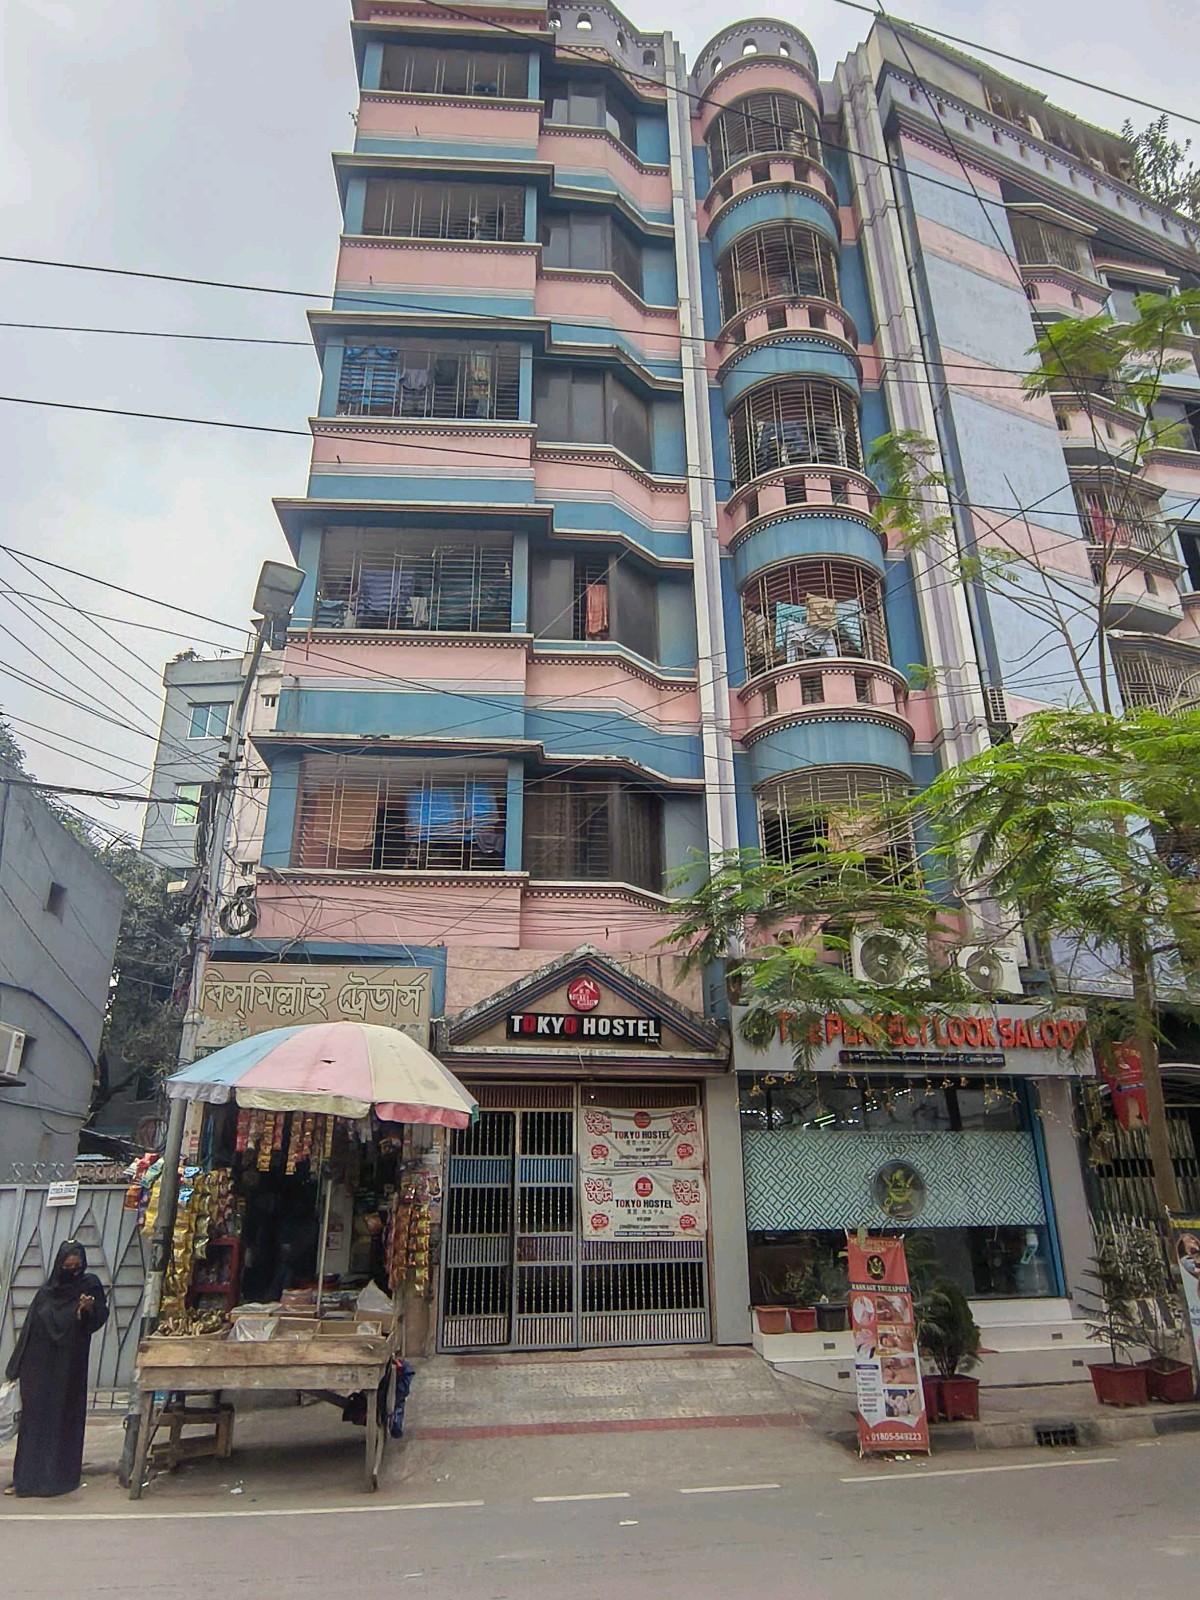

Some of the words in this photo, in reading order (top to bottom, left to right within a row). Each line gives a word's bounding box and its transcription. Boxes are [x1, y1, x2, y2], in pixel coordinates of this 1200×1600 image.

[338, 971, 428, 1019] ট্রেডার্স
[511, 1014, 578, 1034] TOKYO
[583, 1017, 660, 1037] HOSTEL
[933, 1015, 996, 1048] LOOK
[614, 1130, 640, 1139] TOKYO
[642, 1130, 671, 1139] HOSTEL
[615, 1199, 641, 1208] TOKYO
[643, 1199, 673, 1209] HOSTEL
